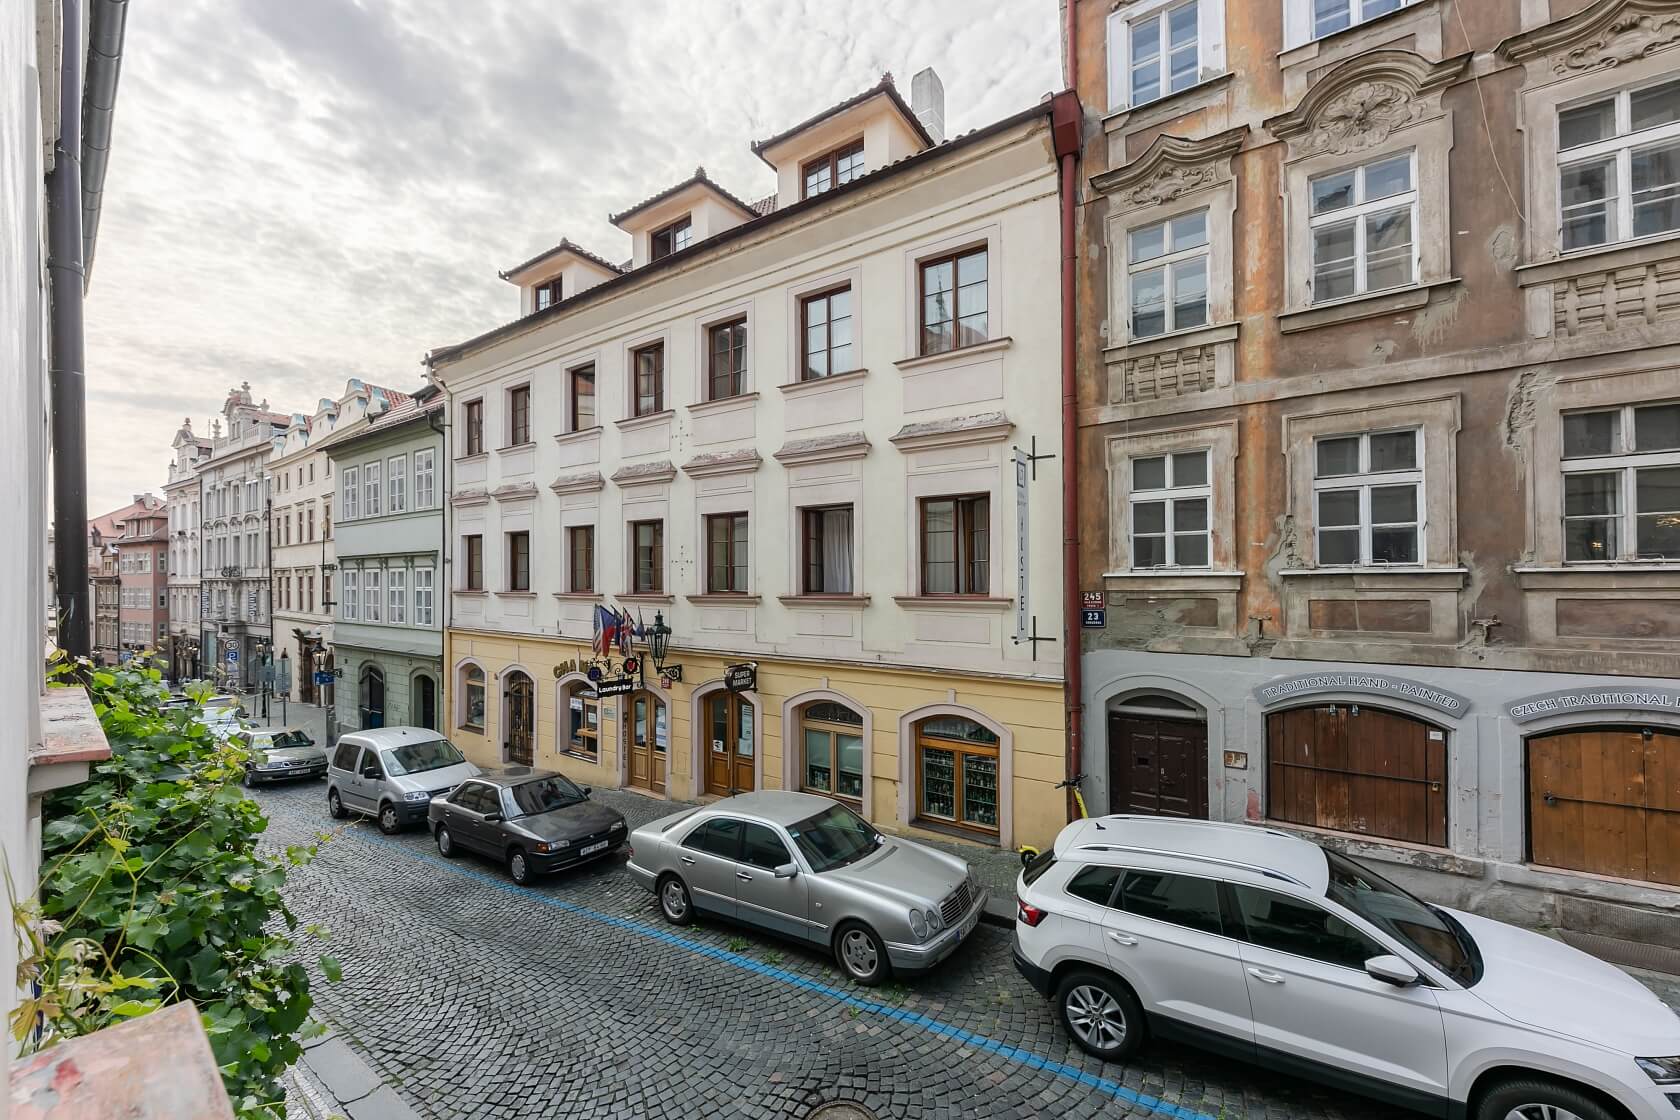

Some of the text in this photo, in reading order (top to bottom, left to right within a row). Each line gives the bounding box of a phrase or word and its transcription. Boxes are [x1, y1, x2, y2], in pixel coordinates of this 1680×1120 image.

[1084, 592, 1101, 601] 245
[1087, 612, 1099, 621] 23
[734, 670, 750, 679] SUPER
[732, 678, 752, 687] MARKET
[598, 685, 621, 693] Laundry
[1262, 675, 1346, 699] TRADITIONAL
[1349, 675, 1389, 689] HAND
[1400, 682, 1460, 711] PAINTED
[1511, 698, 1558, 718] CZECH
[1558, 692, 1673, 708] TRADITIONAL
